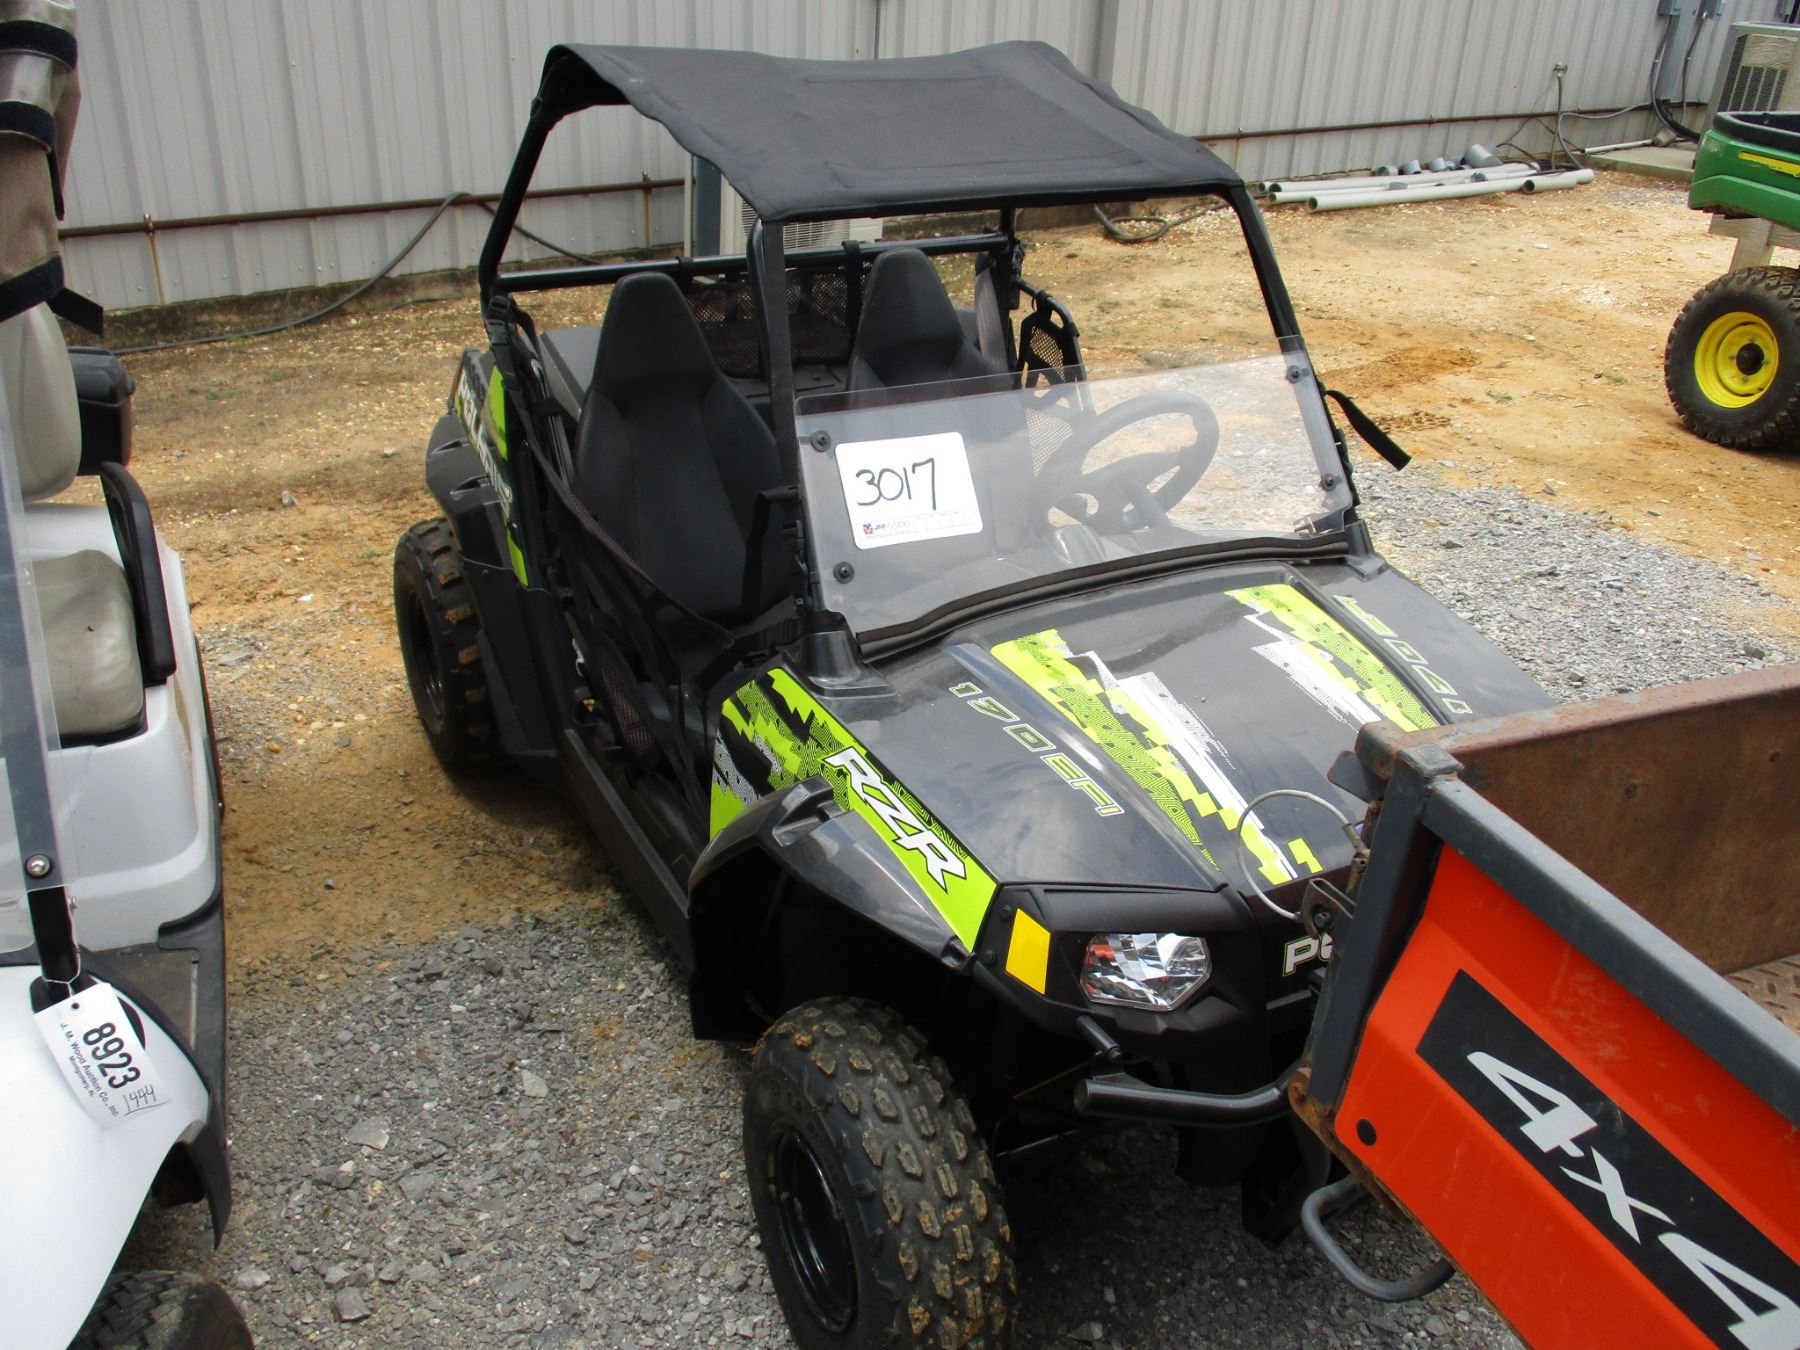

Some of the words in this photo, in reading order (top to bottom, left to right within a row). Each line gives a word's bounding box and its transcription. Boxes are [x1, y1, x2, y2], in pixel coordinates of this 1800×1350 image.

[856, 458, 937, 511] 3017
[820, 746, 966, 893] RZR
[71, 1041, 86, 1064] Wood
[83, 1064, 101, 1092] Auction
[83, 1022, 141, 1089] 8923
[122, 1084, 157, 1112] 1444
